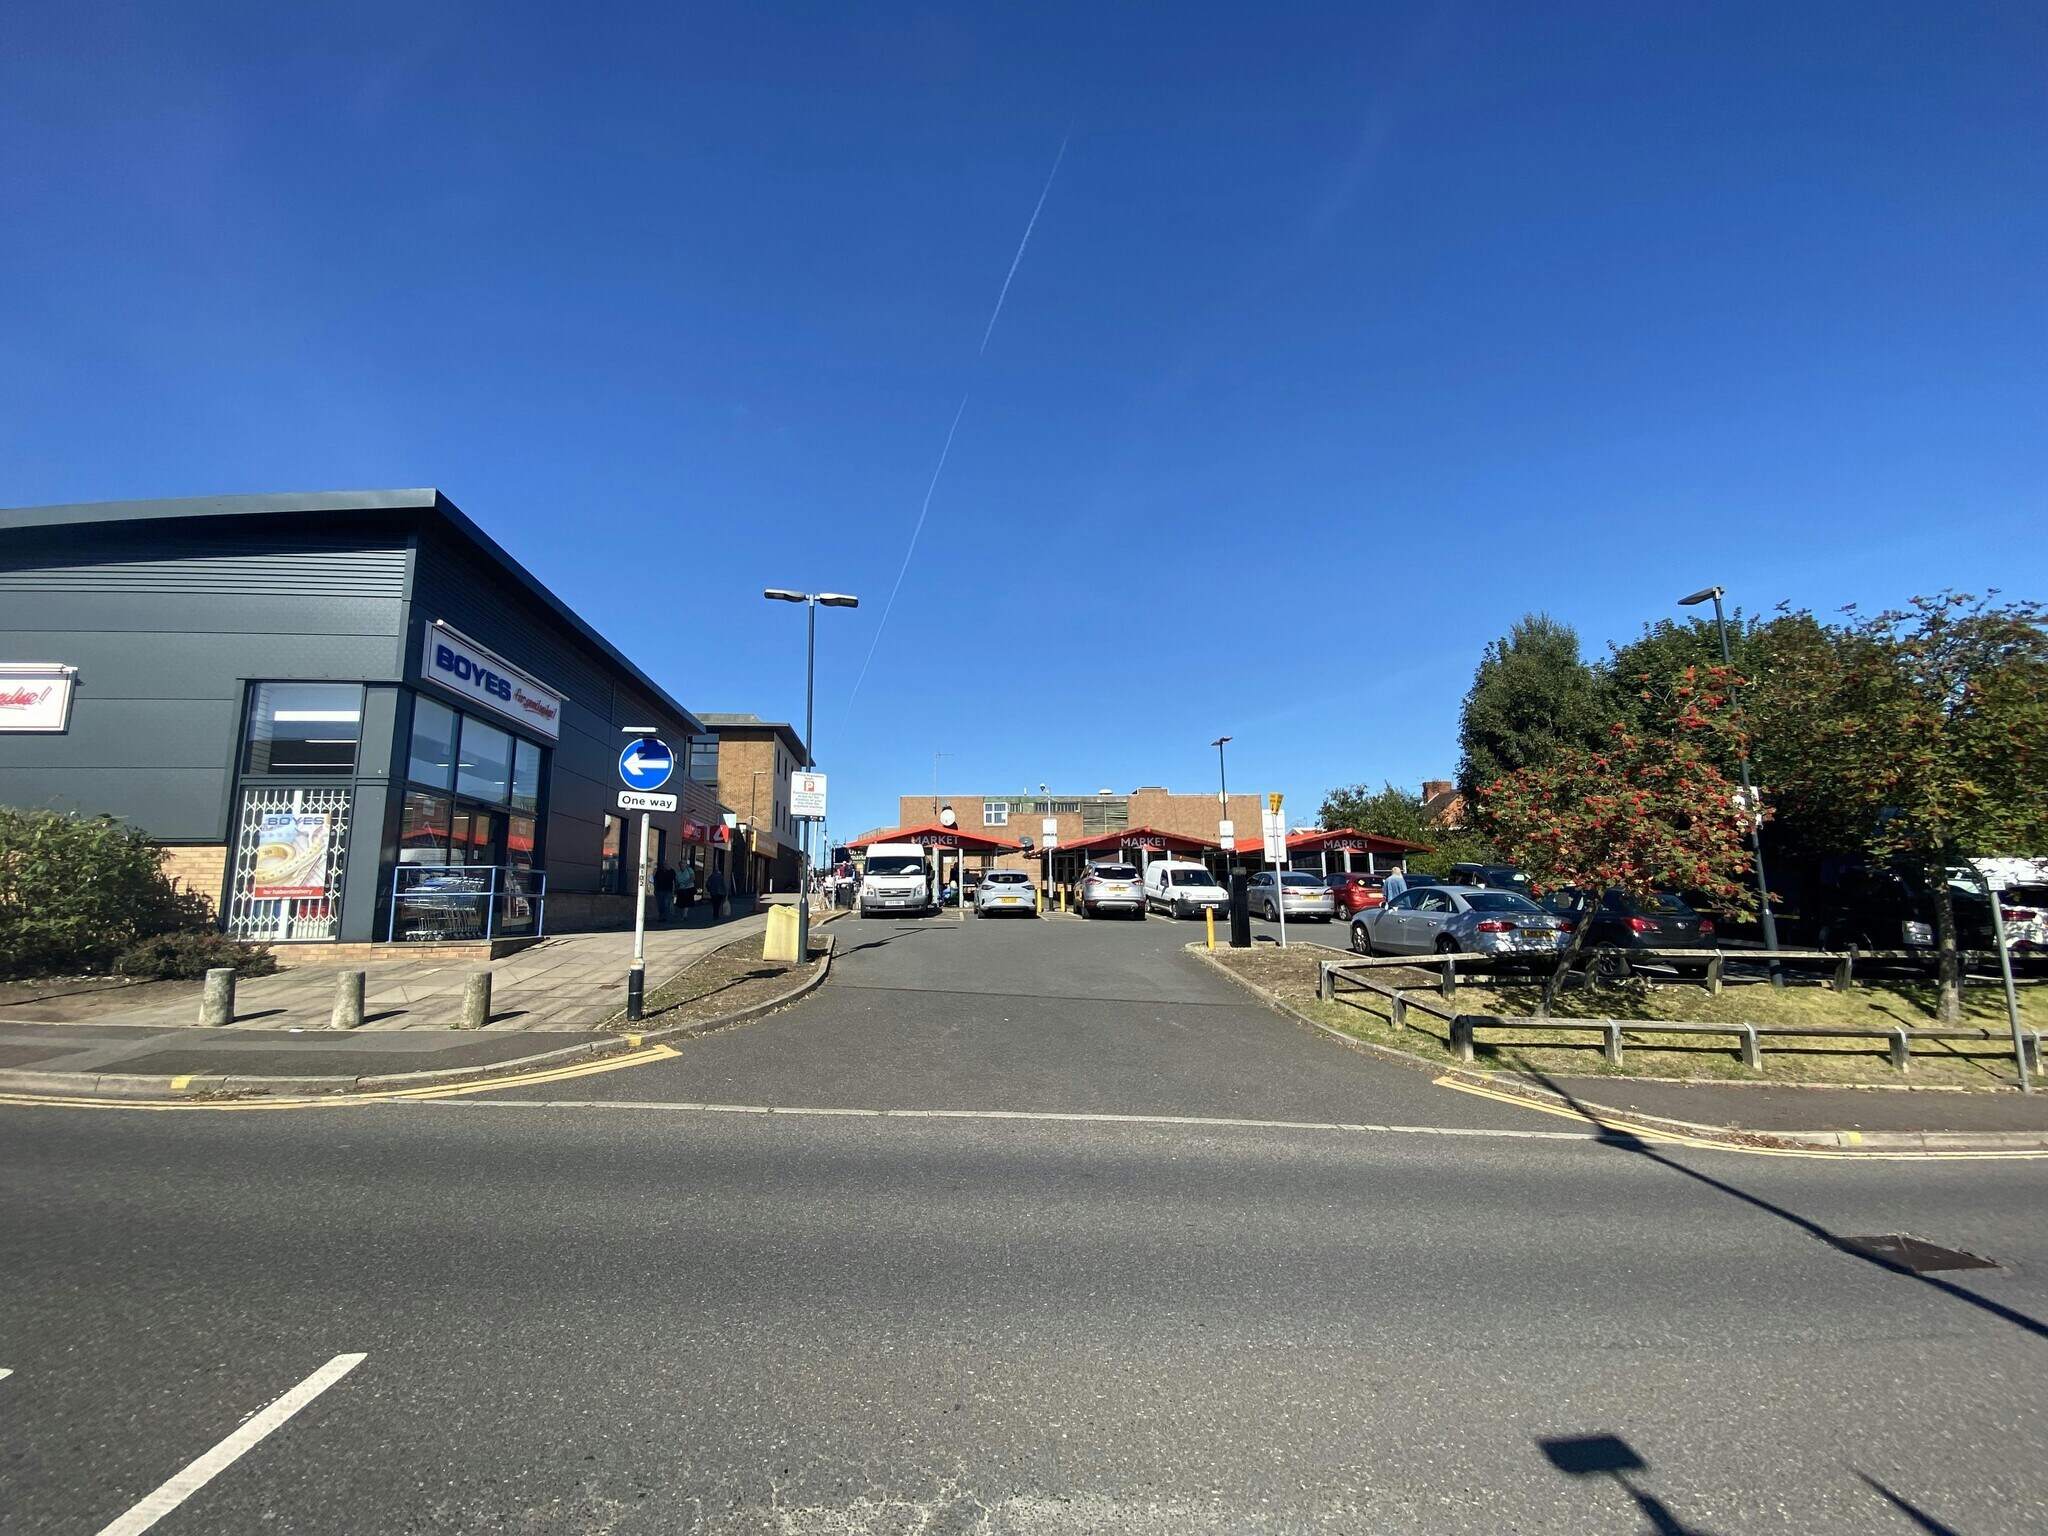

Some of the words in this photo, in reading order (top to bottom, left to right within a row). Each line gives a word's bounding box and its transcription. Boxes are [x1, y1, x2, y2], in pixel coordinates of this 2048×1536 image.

[436, 644, 512, 702] BOYES
[622, 795, 646, 805] One
[650, 798, 673, 809] way
[267, 817, 325, 826] BOYES
[911, 835, 959, 845] MARKET
[1120, 837, 1167, 847] MARKET
[1323, 839, 1369, 849] MARKET
